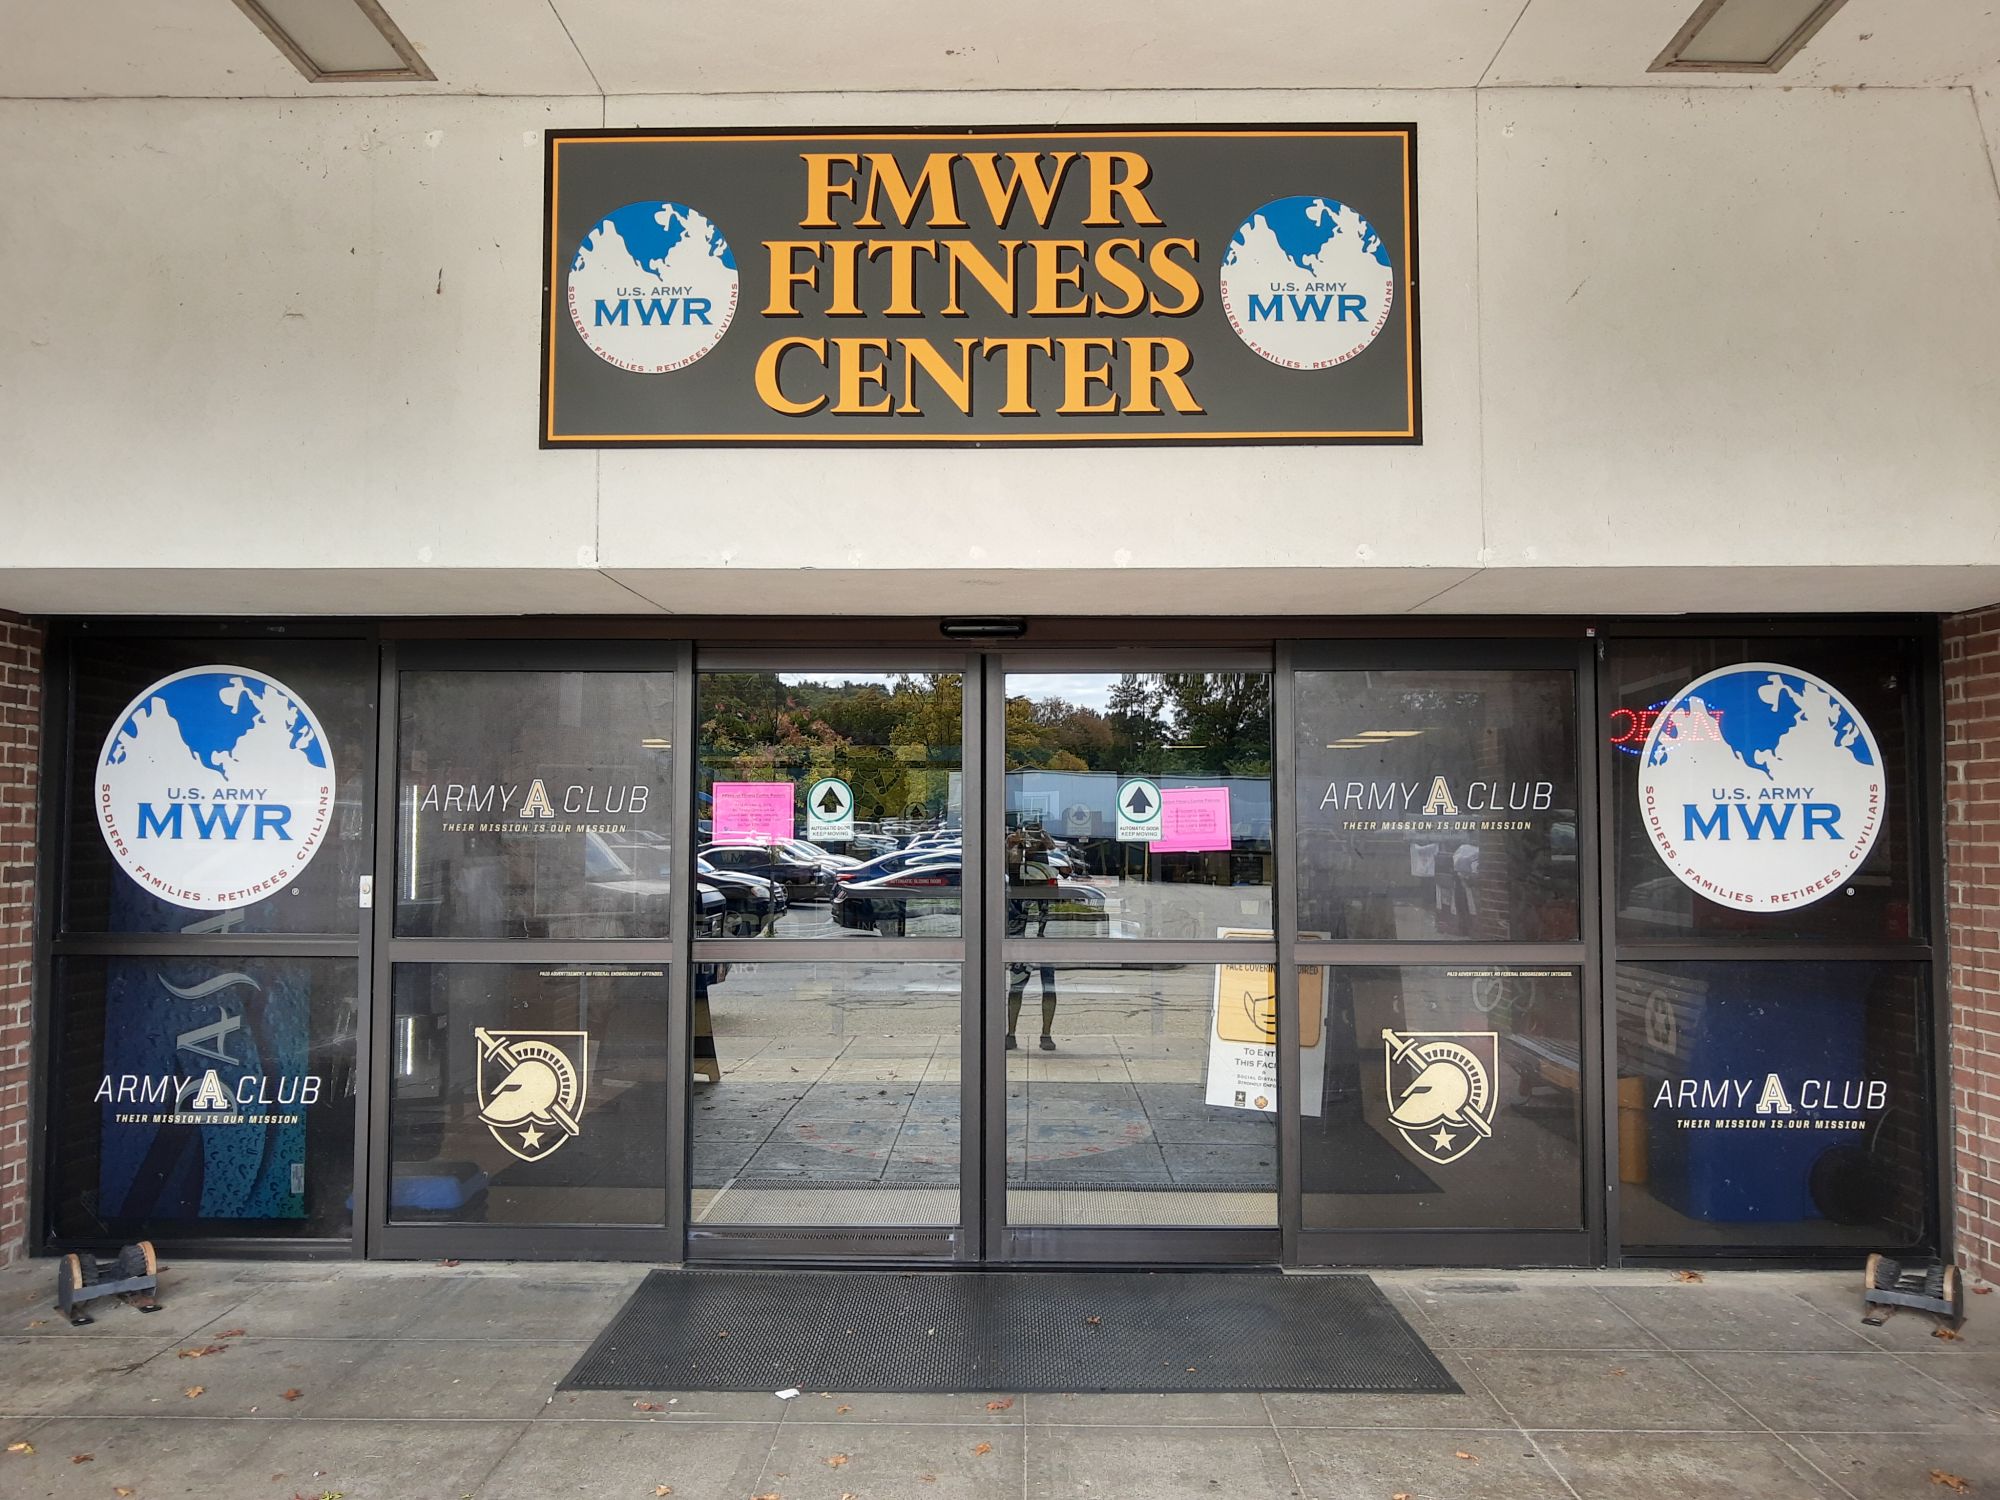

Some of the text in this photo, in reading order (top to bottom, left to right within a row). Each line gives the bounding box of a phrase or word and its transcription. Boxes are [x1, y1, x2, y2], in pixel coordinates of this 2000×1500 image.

[800, 152, 1164, 227] FMWR
[617, 286, 692, 296] U.S. ARMY
[762, 238, 1202, 316] FITNESS
[1271, 283, 1347, 291] U.S. ARMY
[594, 298, 714, 326] MWR
[1221, 280, 1392, 368] SOLDIERS FAMILIES RETIREES CIVILIANS
[1247, 294, 1369, 322] MWR
[568, 283, 738, 372] SOLDIERS FAMILIES RETIREES CIVILIANS
[756, 337, 1203, 415] CENTER
[168, 788, 268, 800] U.S. ARMY
[421, 779, 649, 818] ARMY A CLUB
[1319, 776, 1553, 816] ARMY A CLUB
[1712, 788, 1814, 799] U.S. ARMY
[137, 802, 294, 841] MWR
[443, 823, 626, 833] THEIR MISSION IS OUR MISSION
[1343, 822, 1531, 830] THEIR MISSION IS OUR MISSION
[1683, 803, 1843, 841] MWR
[102, 783, 328, 902] SOLDIERS FAMILIES RETIREES CIVILIANS
[1646, 784, 1878, 903] SOLDIERS FAMILIES RETIREES CIVILIANS
[1245, 964, 1275, 972] COVERIN
[1235, 1059, 1254, 1067] THIS
[94, 1070, 321, 1109] ARMY A CLUB
[1653, 1073, 1887, 1114] ARMY A CLUB
[116, 1114, 298, 1124] THEIR MISSION IS OUR MISSION
[1677, 1120, 1866, 1129] THEIR MISSION IS OUR MISSION
